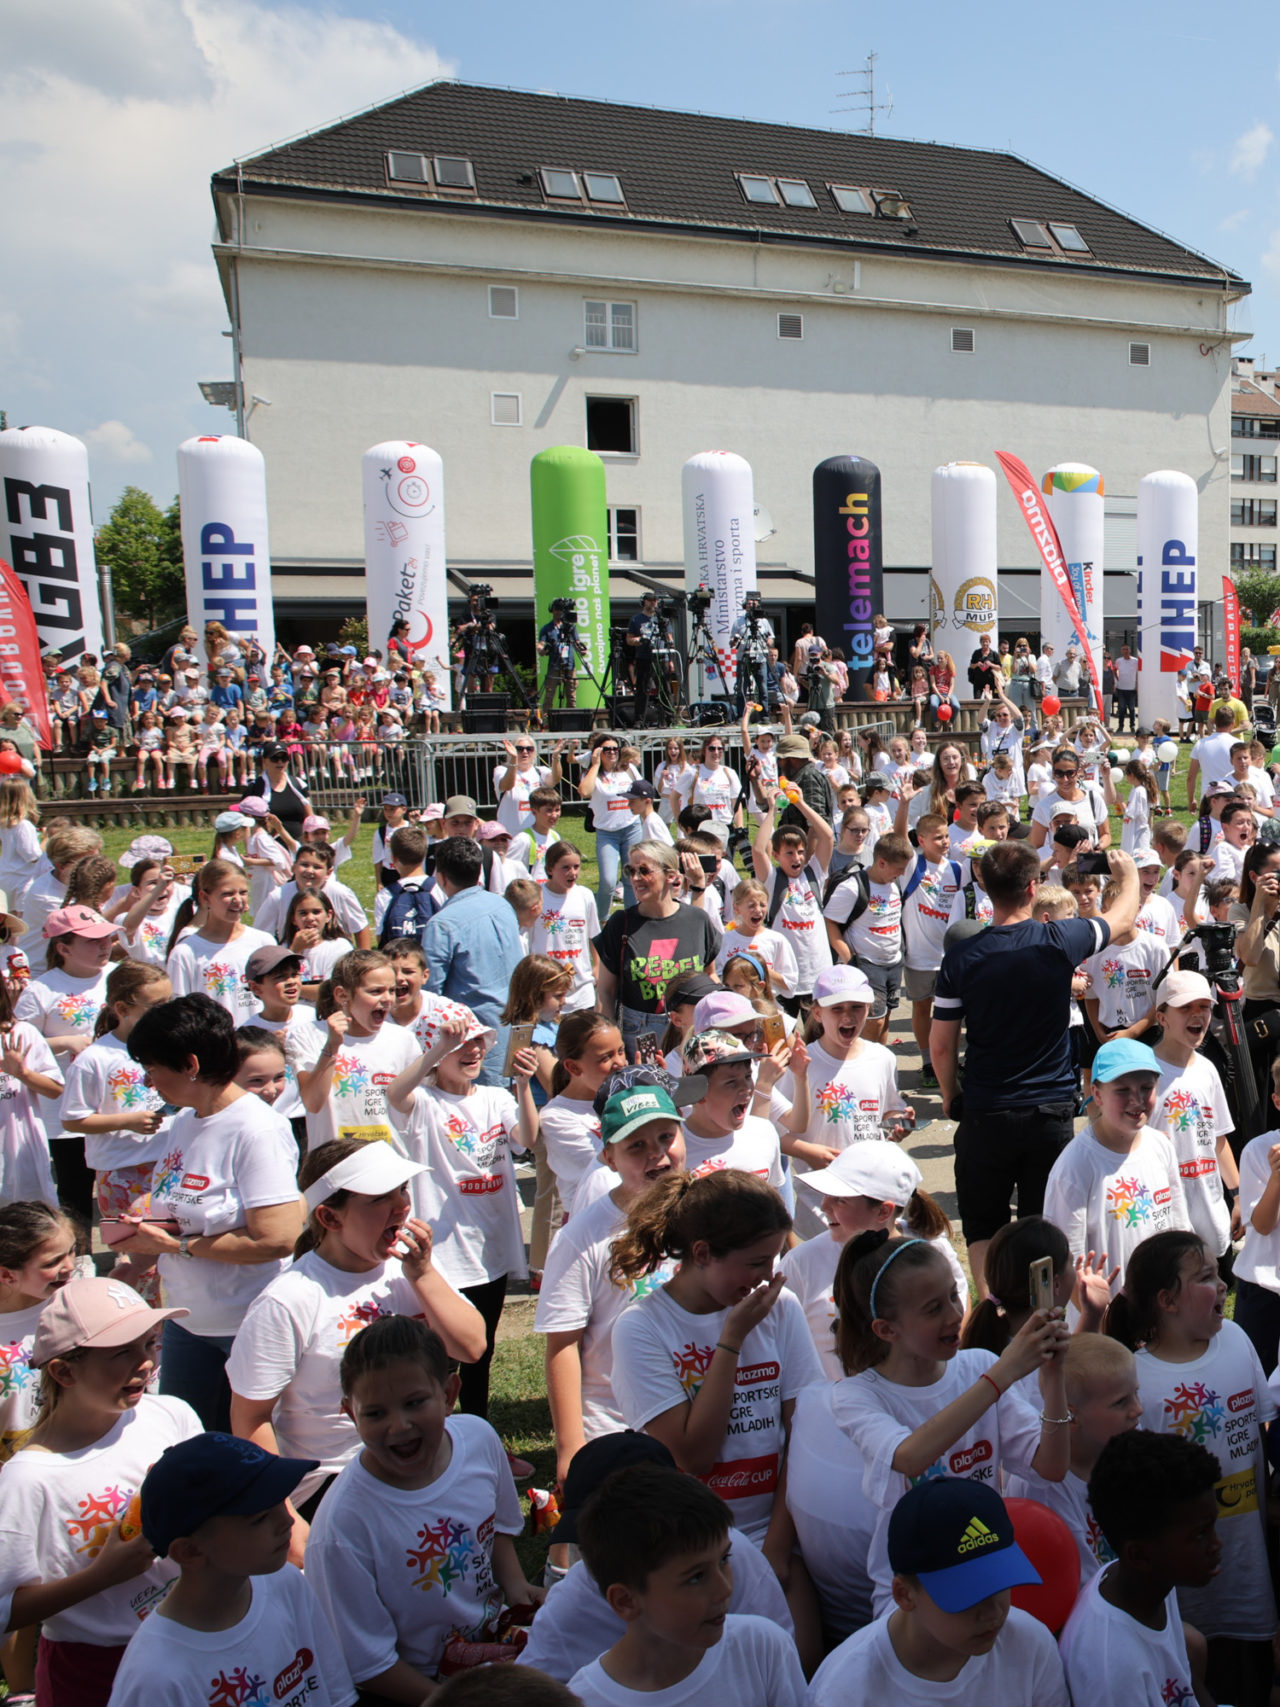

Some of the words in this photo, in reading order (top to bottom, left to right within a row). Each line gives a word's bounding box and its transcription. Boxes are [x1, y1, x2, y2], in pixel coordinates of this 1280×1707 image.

[695, 493, 709, 561] HRVATSKA
[729, 518, 744, 566] sporta
[201, 522, 258, 632] HEP
[569, 554, 592, 592] igre
[590, 554, 603, 595] planet
[839, 492, 874, 671] telemach
[1160, 539, 1196, 627] HEP
[713, 539, 730, 635] Ministarstvo
[592, 598, 602, 620] naš
[966, 593, 993, 610] RH
[965, 613, 993, 622] MUP
[918, 903, 950, 920] TOMMY
[782, 918, 815, 930] TOMMY
[547, 949, 582, 959] TOMMY
[365, 1098, 381, 1107] IGRE
[853, 1124, 869, 1132] IGRE
[733, 1384, 780, 1404] PORTSKE
[729, 1406, 754, 1421] GRE
[727, 1416, 776, 1436] MLADIH
[1227, 1429, 1250, 1446] IGRE
[751, 1469, 773, 1483] CUP
[957, 1532, 1000, 1555] adidas
[129, 1585, 158, 1610] UEFA
